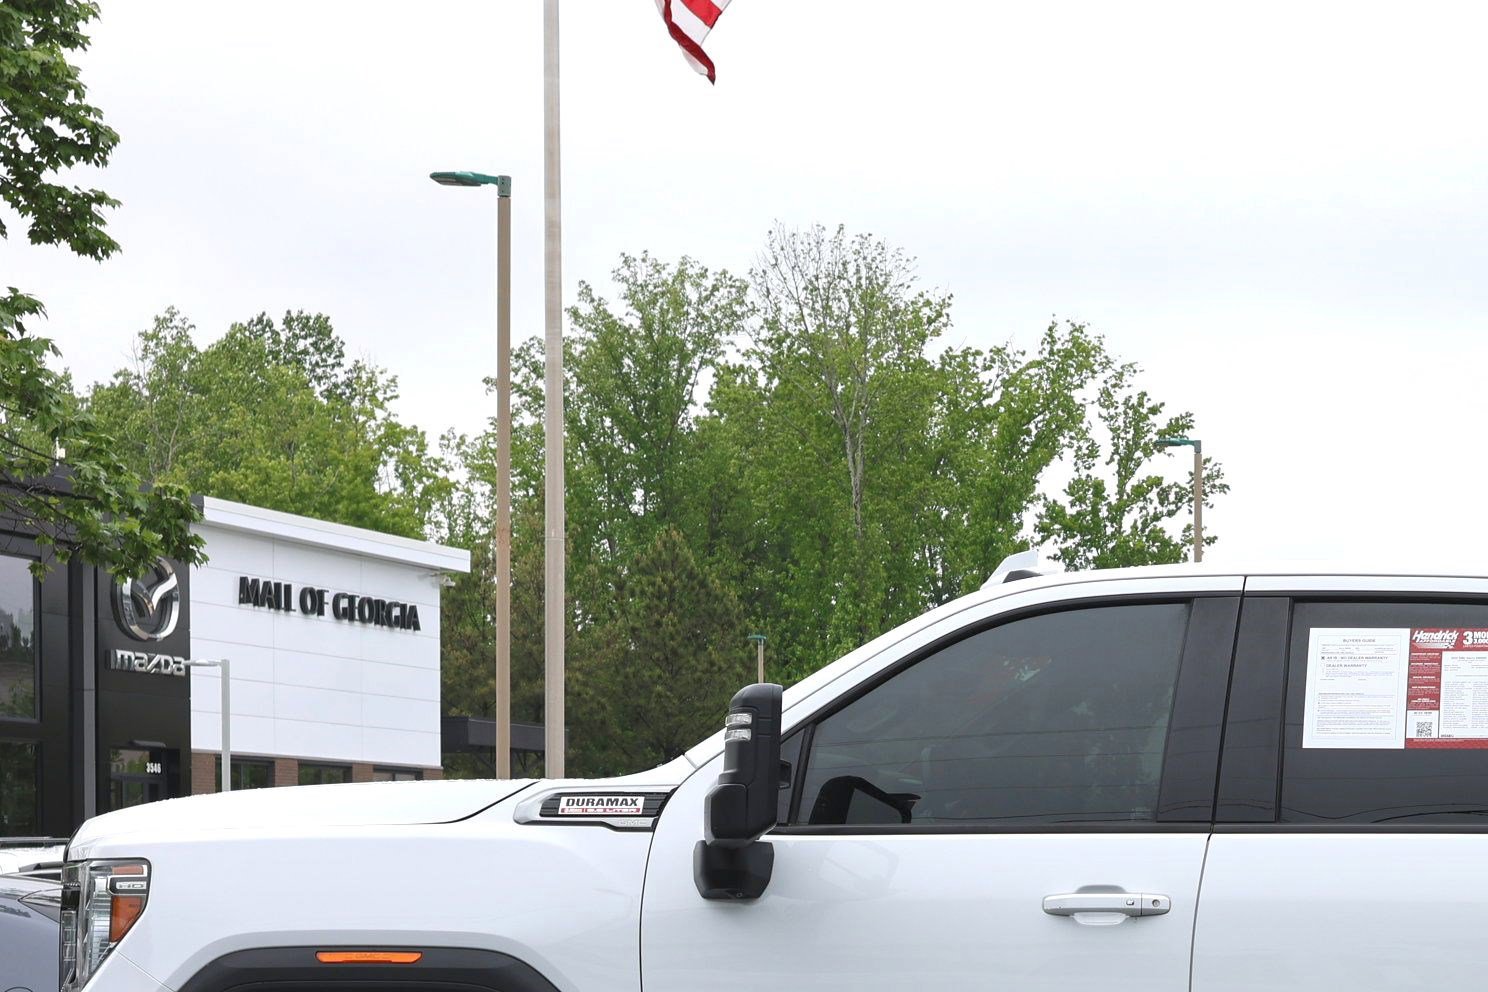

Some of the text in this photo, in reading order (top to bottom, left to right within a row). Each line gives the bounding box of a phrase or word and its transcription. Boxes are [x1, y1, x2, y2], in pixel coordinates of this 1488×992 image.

[238, 576, 421, 631] MALL OF GEORGIA
[1462, 631, 1473, 645] 3
[565, 798, 638, 807] DURAMAX
